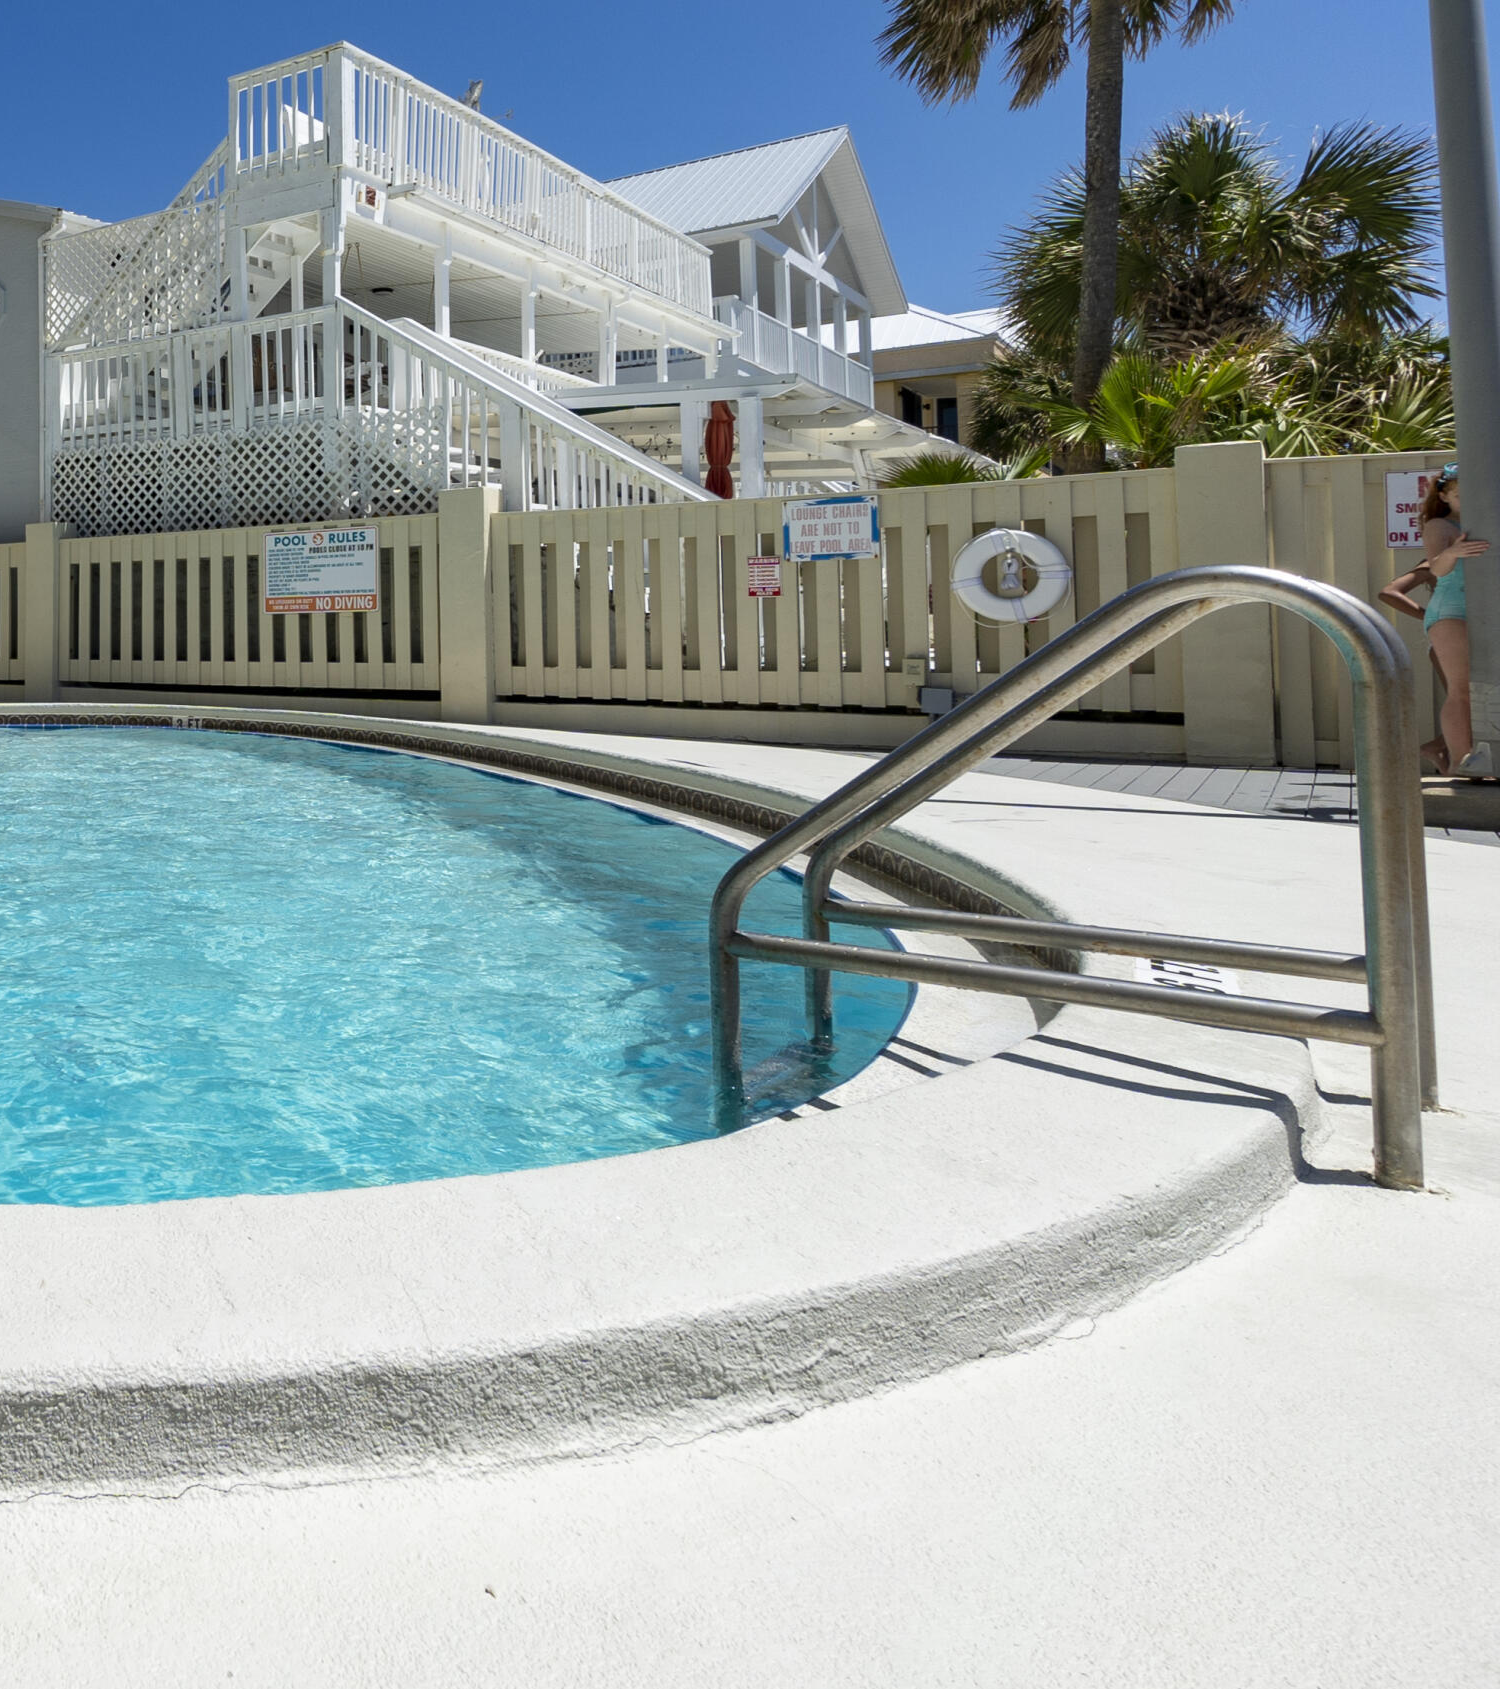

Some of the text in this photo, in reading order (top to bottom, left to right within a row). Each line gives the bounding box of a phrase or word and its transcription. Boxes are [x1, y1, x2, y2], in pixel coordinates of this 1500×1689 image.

[791, 504, 869, 520] LOUNGE CHAIRS
[801, 521, 859, 537] ARE NOT TO
[1389, 532, 1408, 542] ON
[274, 531, 366, 547] POOL RULES
[790, 538, 871, 554] LEAVE POOL AREA
[328, 544, 346, 553] CLOSE
[348, 544, 356, 552] AT
[357, 544, 364, 552] 10
[365, 543, 374, 551] PM
[315, 595, 374, 610] NO DIVING
